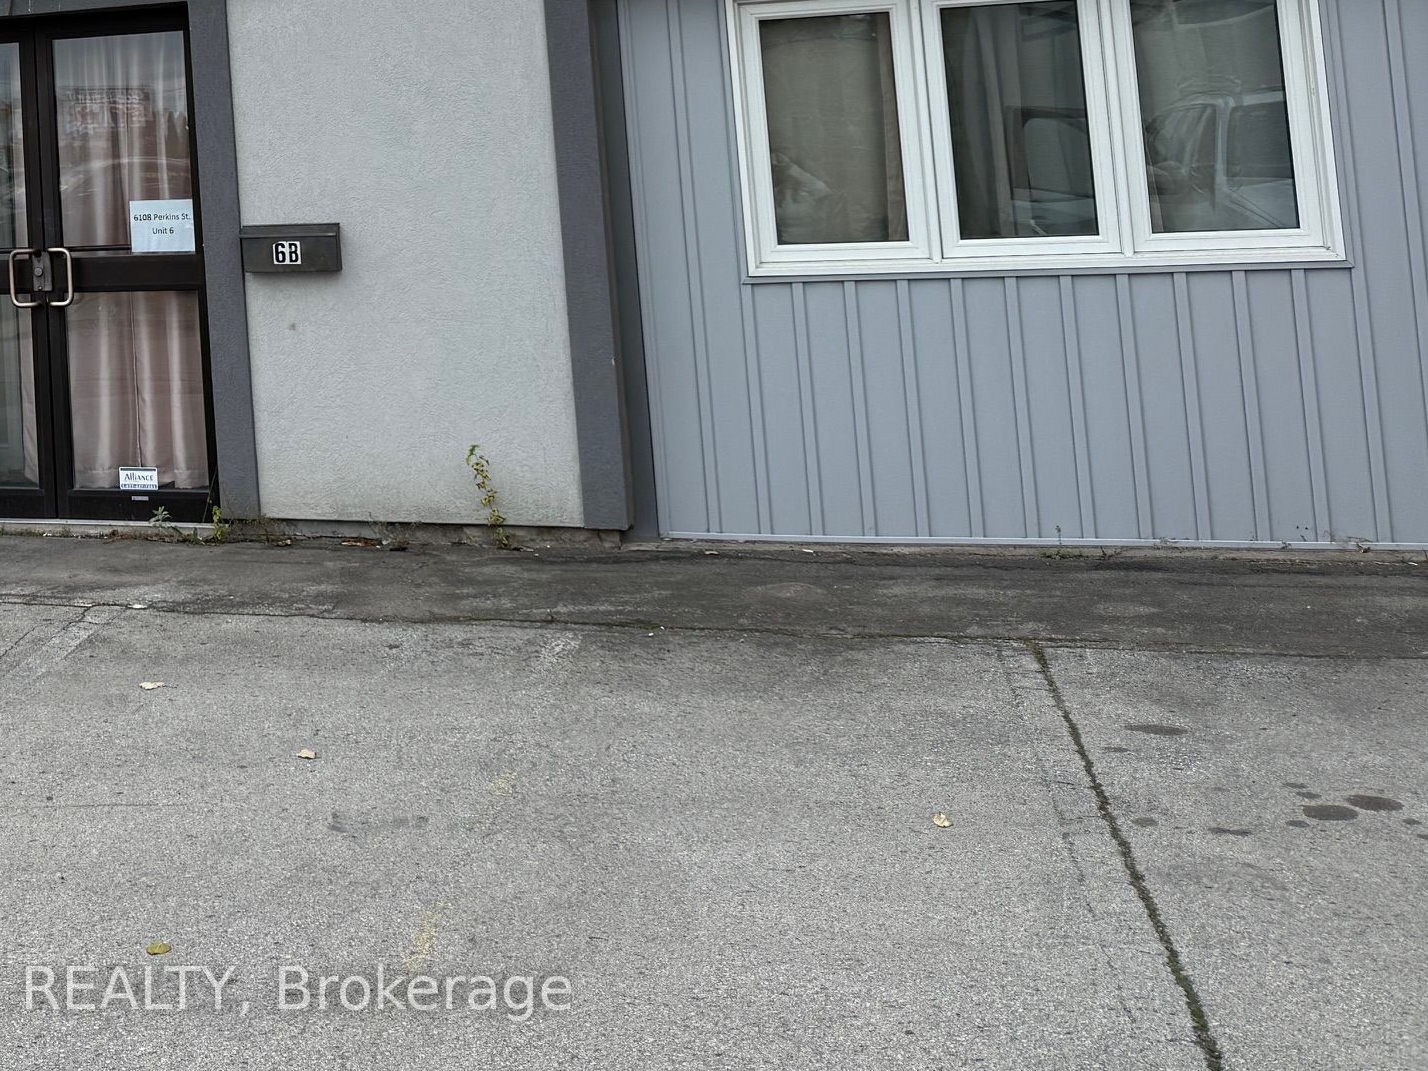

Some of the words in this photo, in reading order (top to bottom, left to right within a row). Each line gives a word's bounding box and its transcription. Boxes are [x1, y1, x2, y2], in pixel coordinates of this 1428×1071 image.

[133, 213, 152, 221] 6108
[153, 213, 180, 221] Perkins
[181, 212, 191, 220] St.
[152, 226, 168, 235] Unit
[169, 226, 175, 235] 6
[274, 242, 299, 264] 6B
